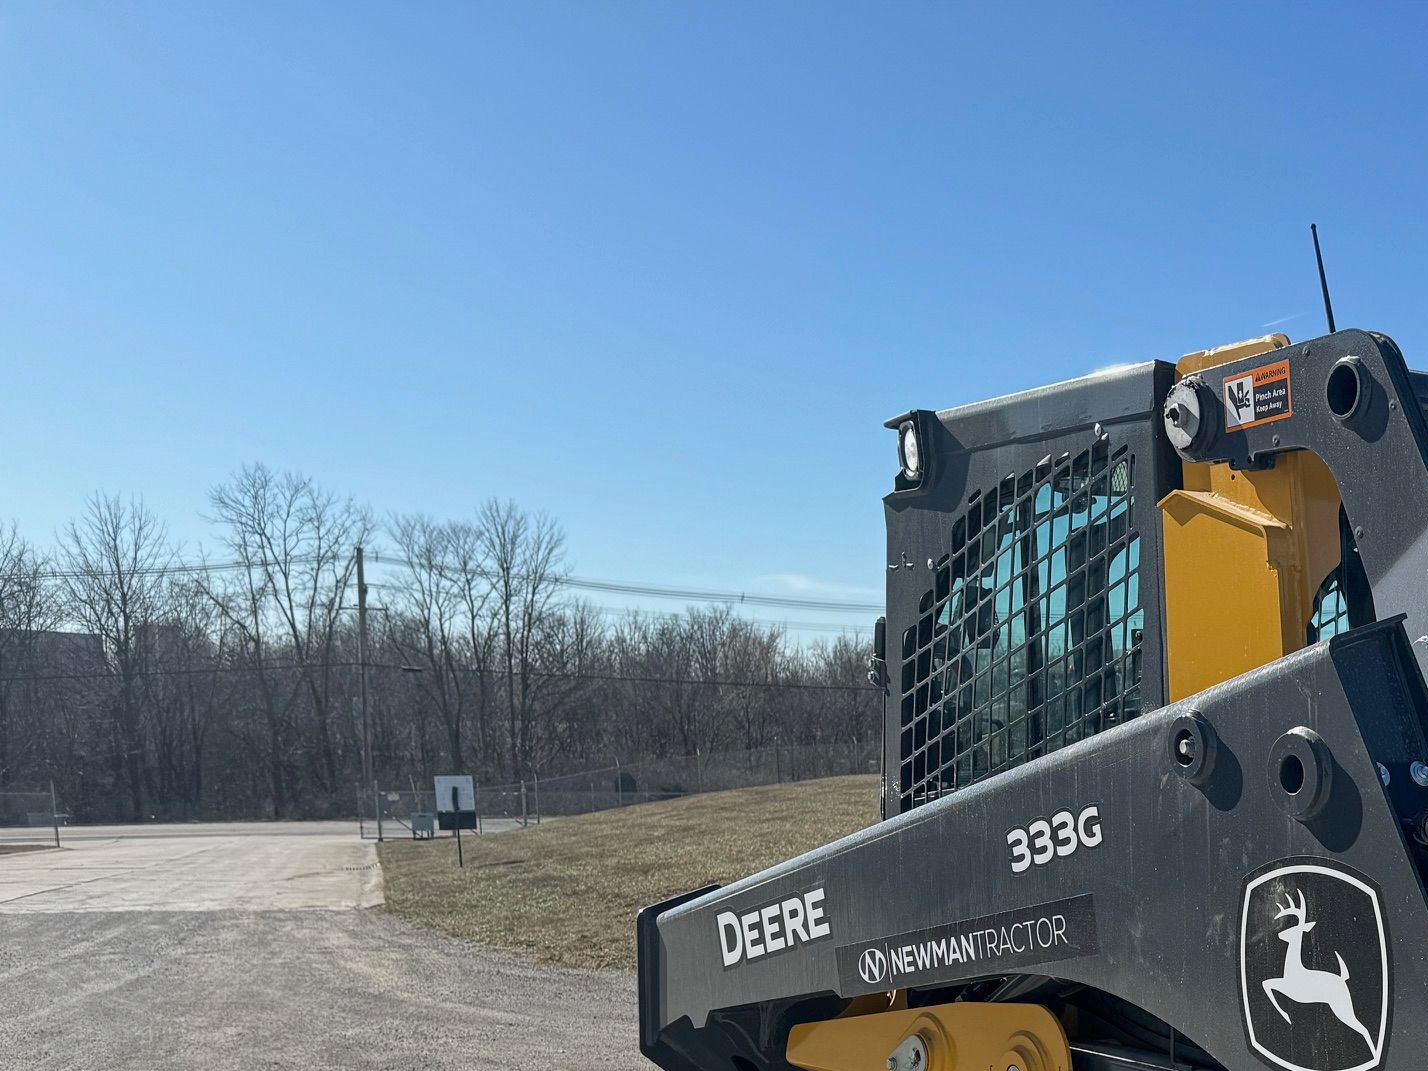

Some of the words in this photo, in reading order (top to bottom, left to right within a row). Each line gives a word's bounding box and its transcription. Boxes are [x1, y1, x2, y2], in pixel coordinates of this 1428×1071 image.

[1260, 367, 1286, 380] WARNING
[1255, 391, 1271, 402] Pinch
[1272, 388, 1286, 397] Area
[1269, 401, 1282, 410] Away
[1006, 806, 1103, 873] 333G
[716, 887, 831, 967] DEERE
